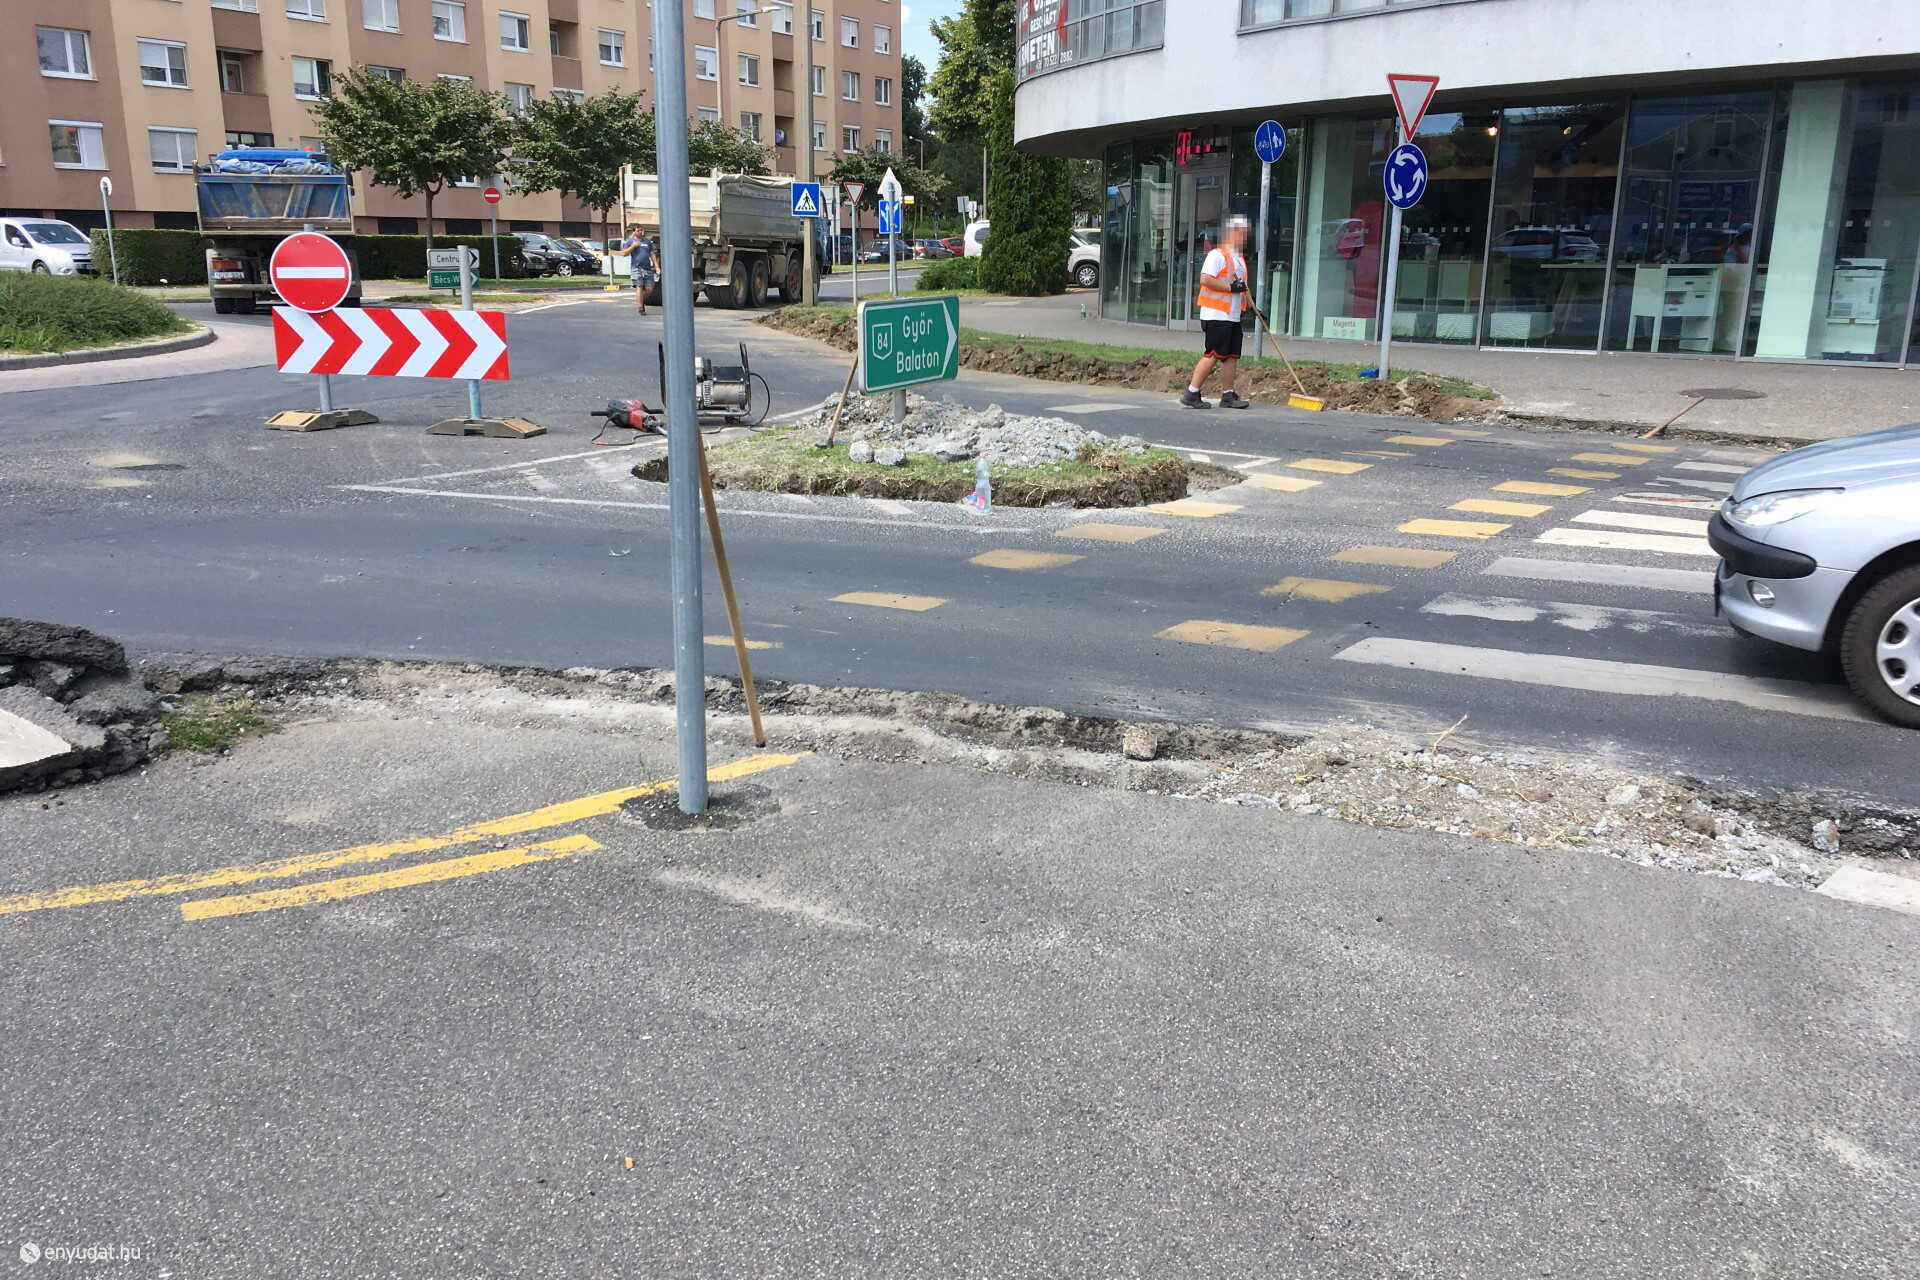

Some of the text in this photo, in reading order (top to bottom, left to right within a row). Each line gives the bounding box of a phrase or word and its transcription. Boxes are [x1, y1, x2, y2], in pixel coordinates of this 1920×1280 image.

[436, 254, 460, 264] Centru
[433, 274, 460, 284] Bécs-W
[902, 312, 933, 343] Győr
[877, 333, 888, 350] 84
[896, 347, 939, 374] Balaton
